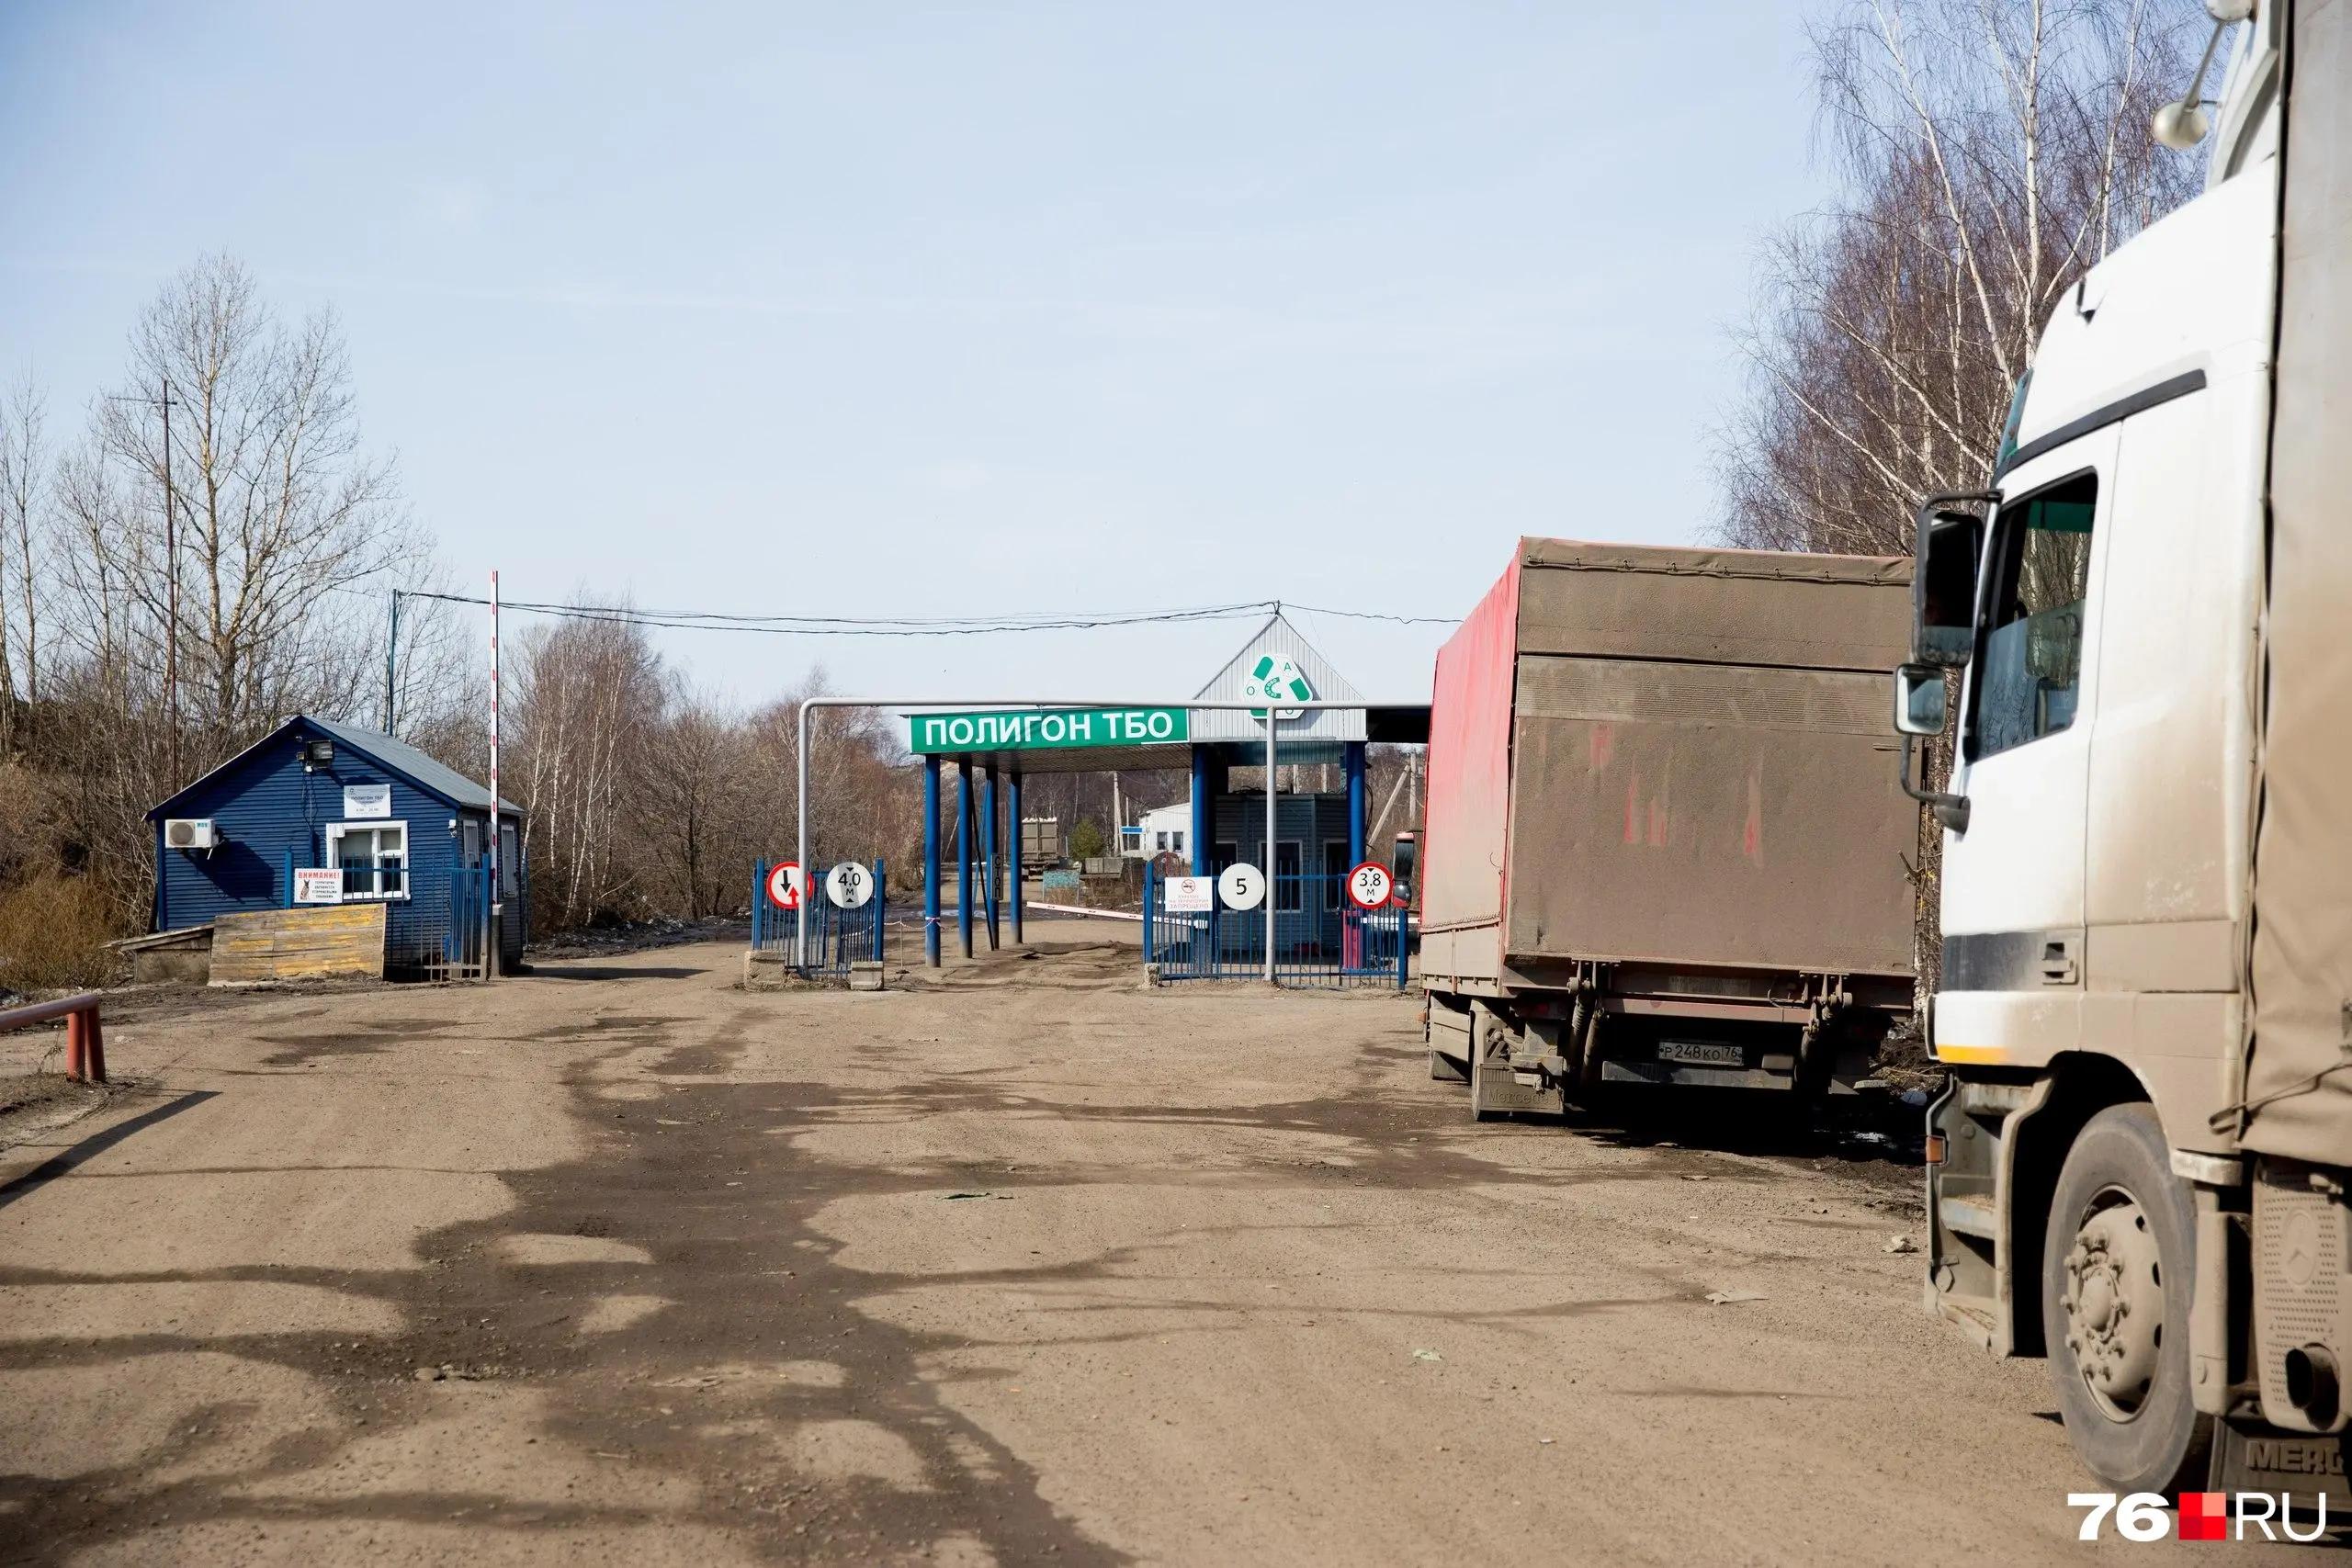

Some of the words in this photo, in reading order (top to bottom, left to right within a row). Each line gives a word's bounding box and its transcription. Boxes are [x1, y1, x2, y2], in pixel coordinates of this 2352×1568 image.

[925, 714, 1091, 746] ПОЛИГОН
[1102, 711, 1173, 739] ТБО
[1236, 877, 1248, 896] 5
